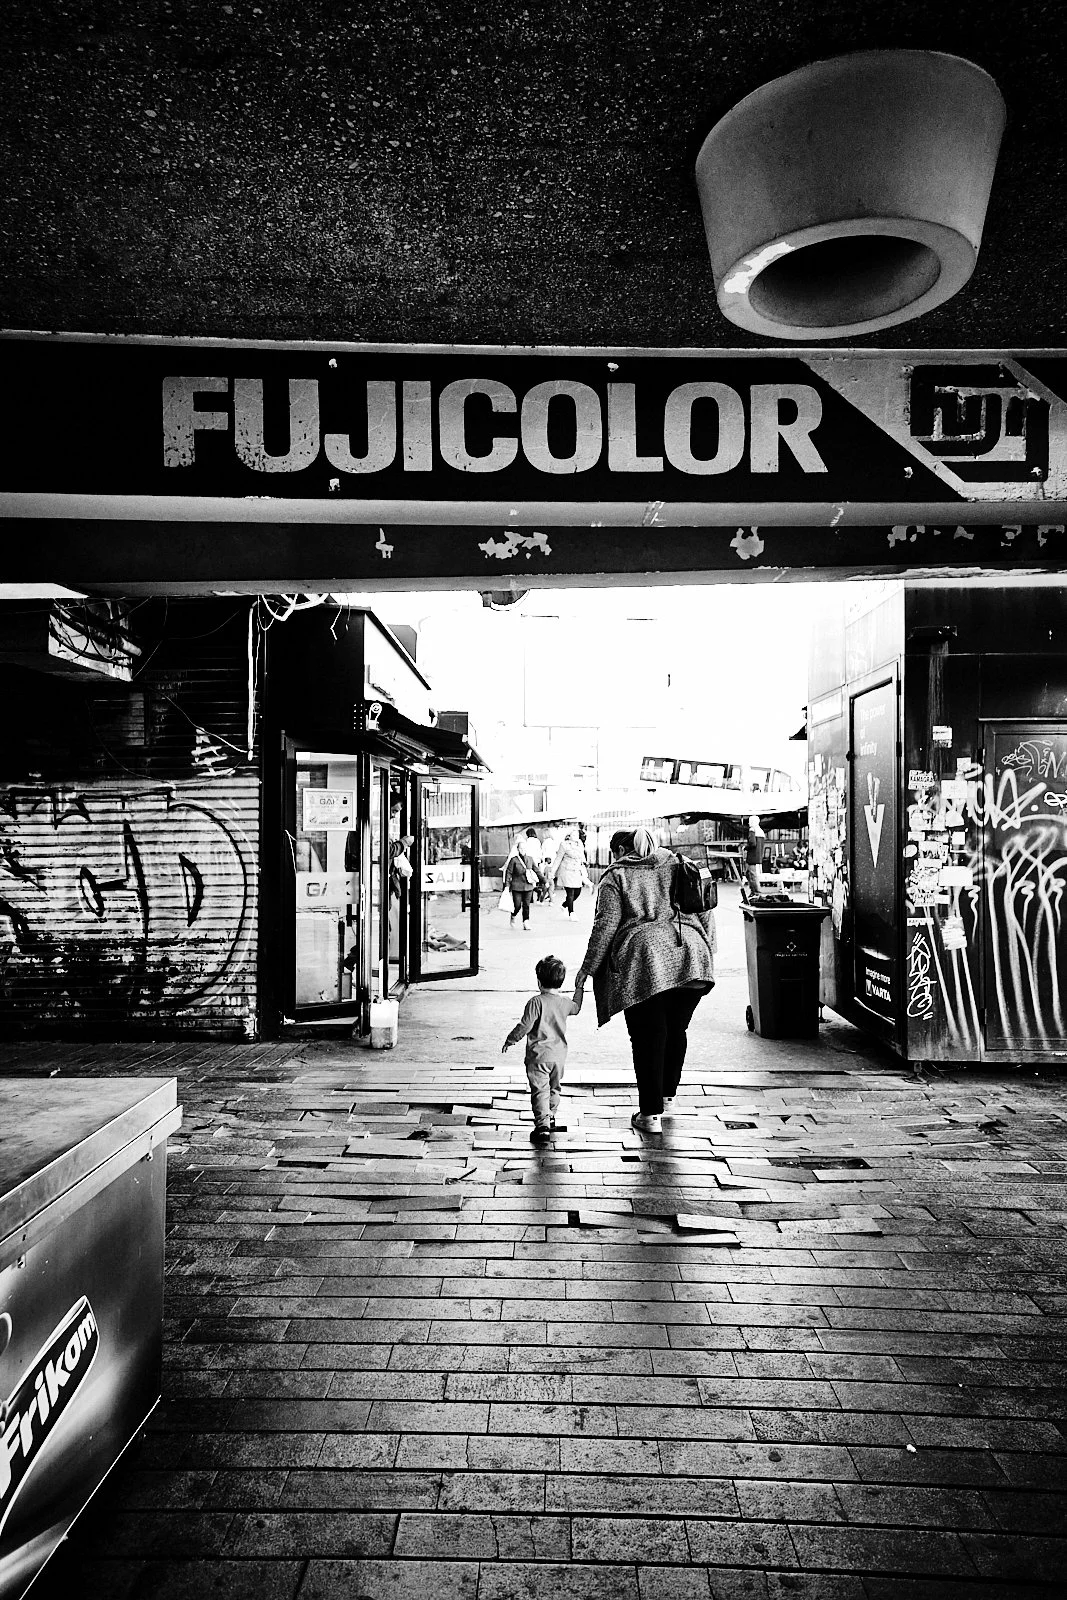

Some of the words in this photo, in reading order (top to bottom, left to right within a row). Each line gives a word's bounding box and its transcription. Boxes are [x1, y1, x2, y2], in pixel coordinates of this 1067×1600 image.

[162, 376, 828, 476] FUJICOLOR
[871, 983, 892, 1002] VARTA
[0, 1311, 96, 1499] Frikom
